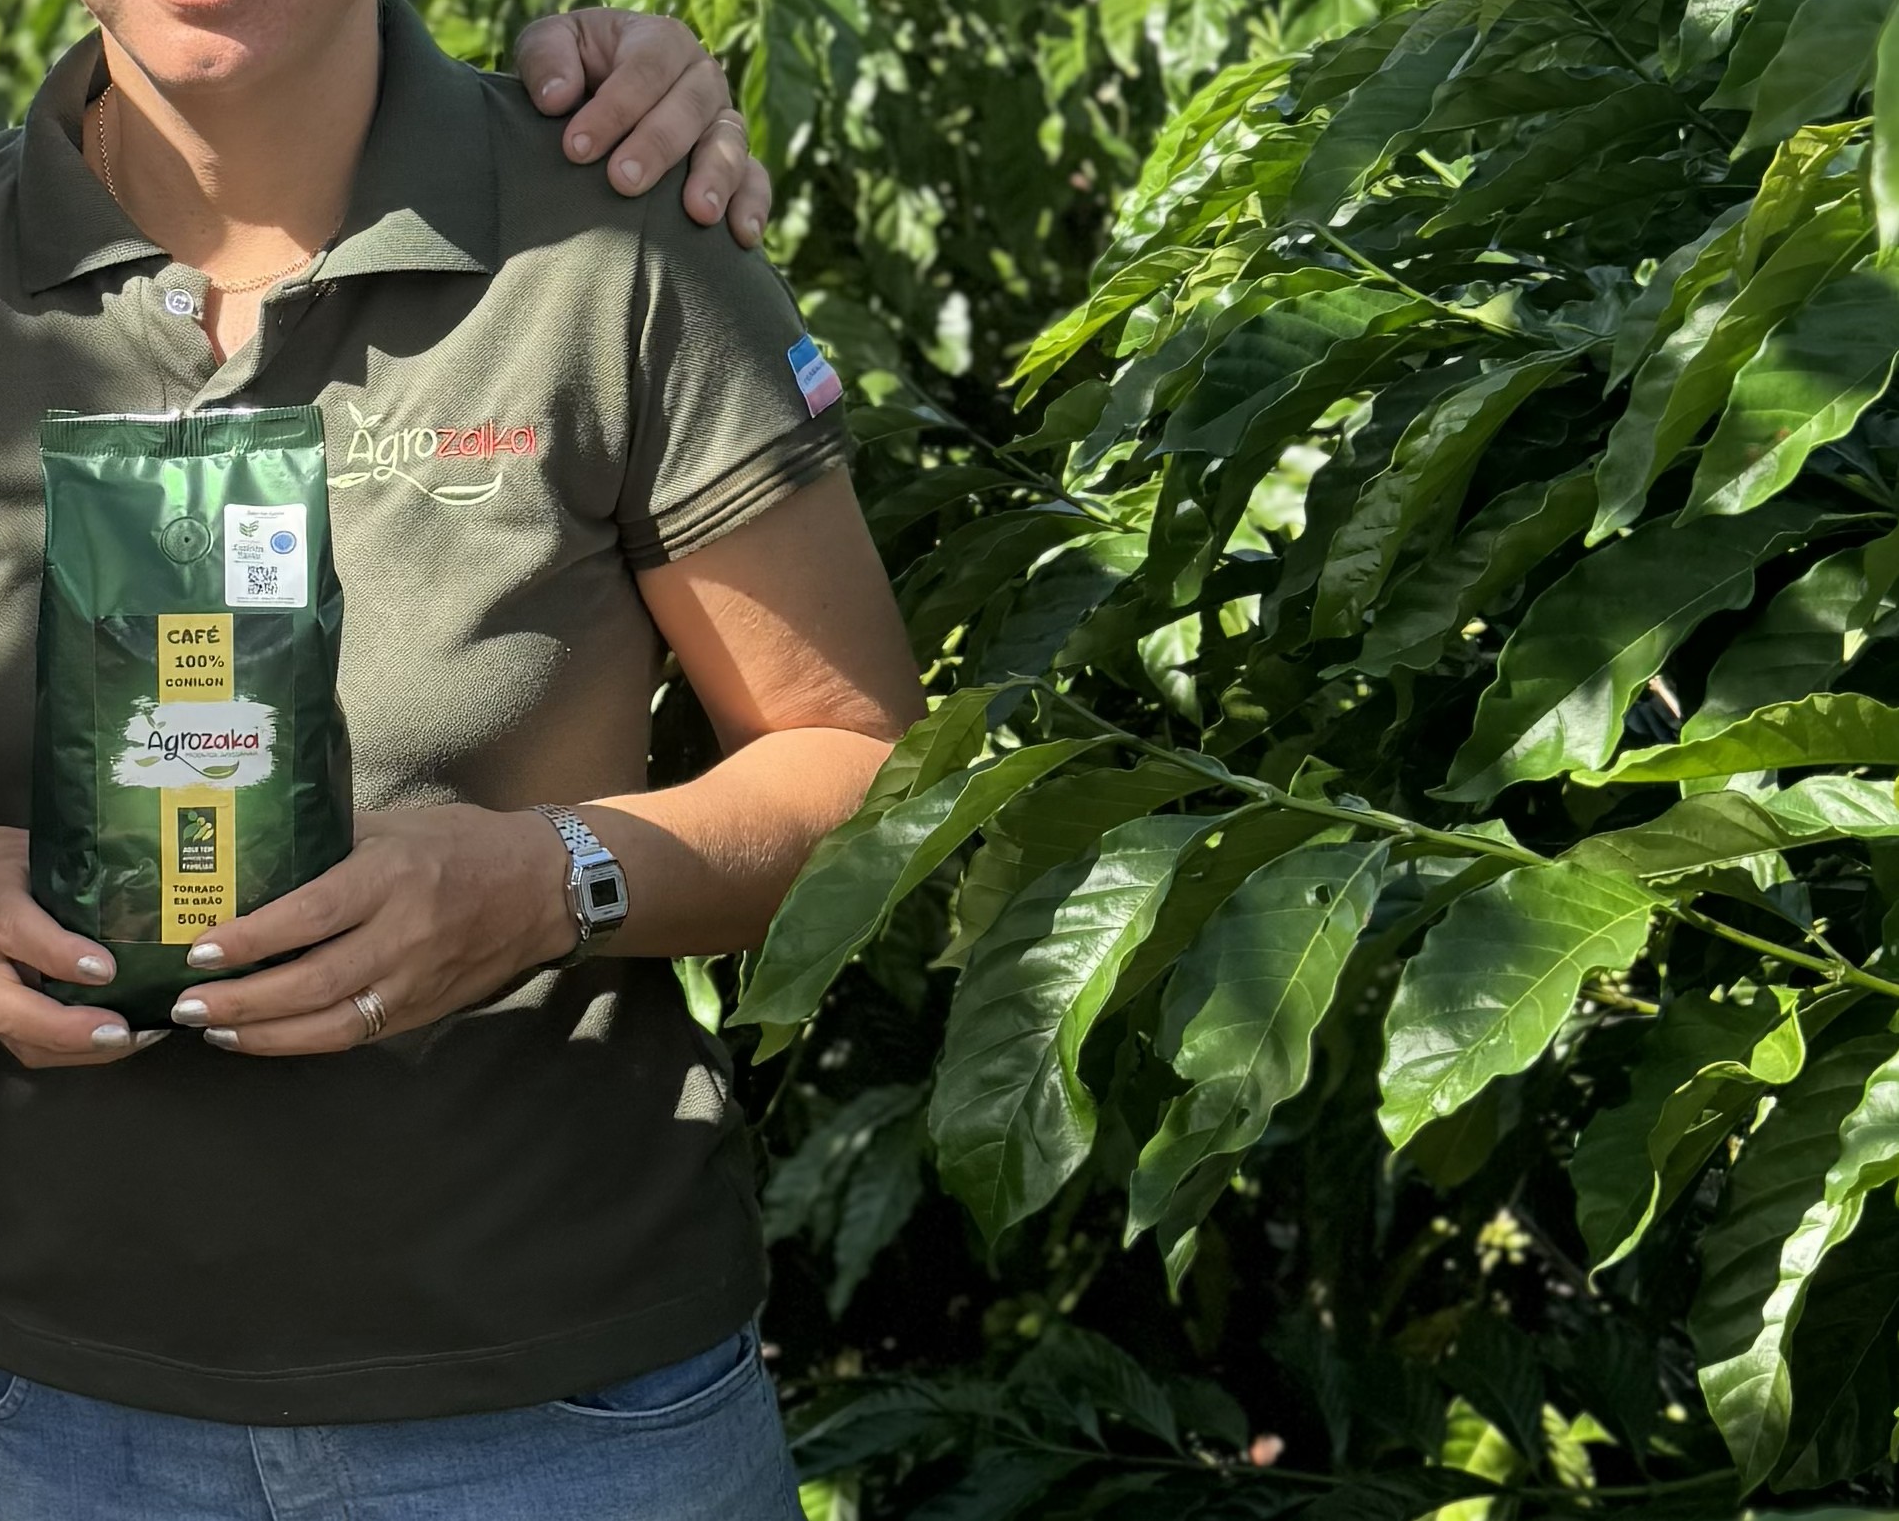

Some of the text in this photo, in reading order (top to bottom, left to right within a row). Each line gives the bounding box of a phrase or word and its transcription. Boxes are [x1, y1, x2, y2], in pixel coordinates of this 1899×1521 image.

[347, 418, 537, 481] Agrozaka
[166, 625, 221, 644] CAFÉ
[175, 655, 225, 668] 100%
[165, 677, 224, 687] CONILON
[148, 728, 259, 761] Agrozaka
[172, 885, 224, 893] TORRADO
[192, 896, 223, 905] GRÃO
[177, 913, 217, 927] 500g
